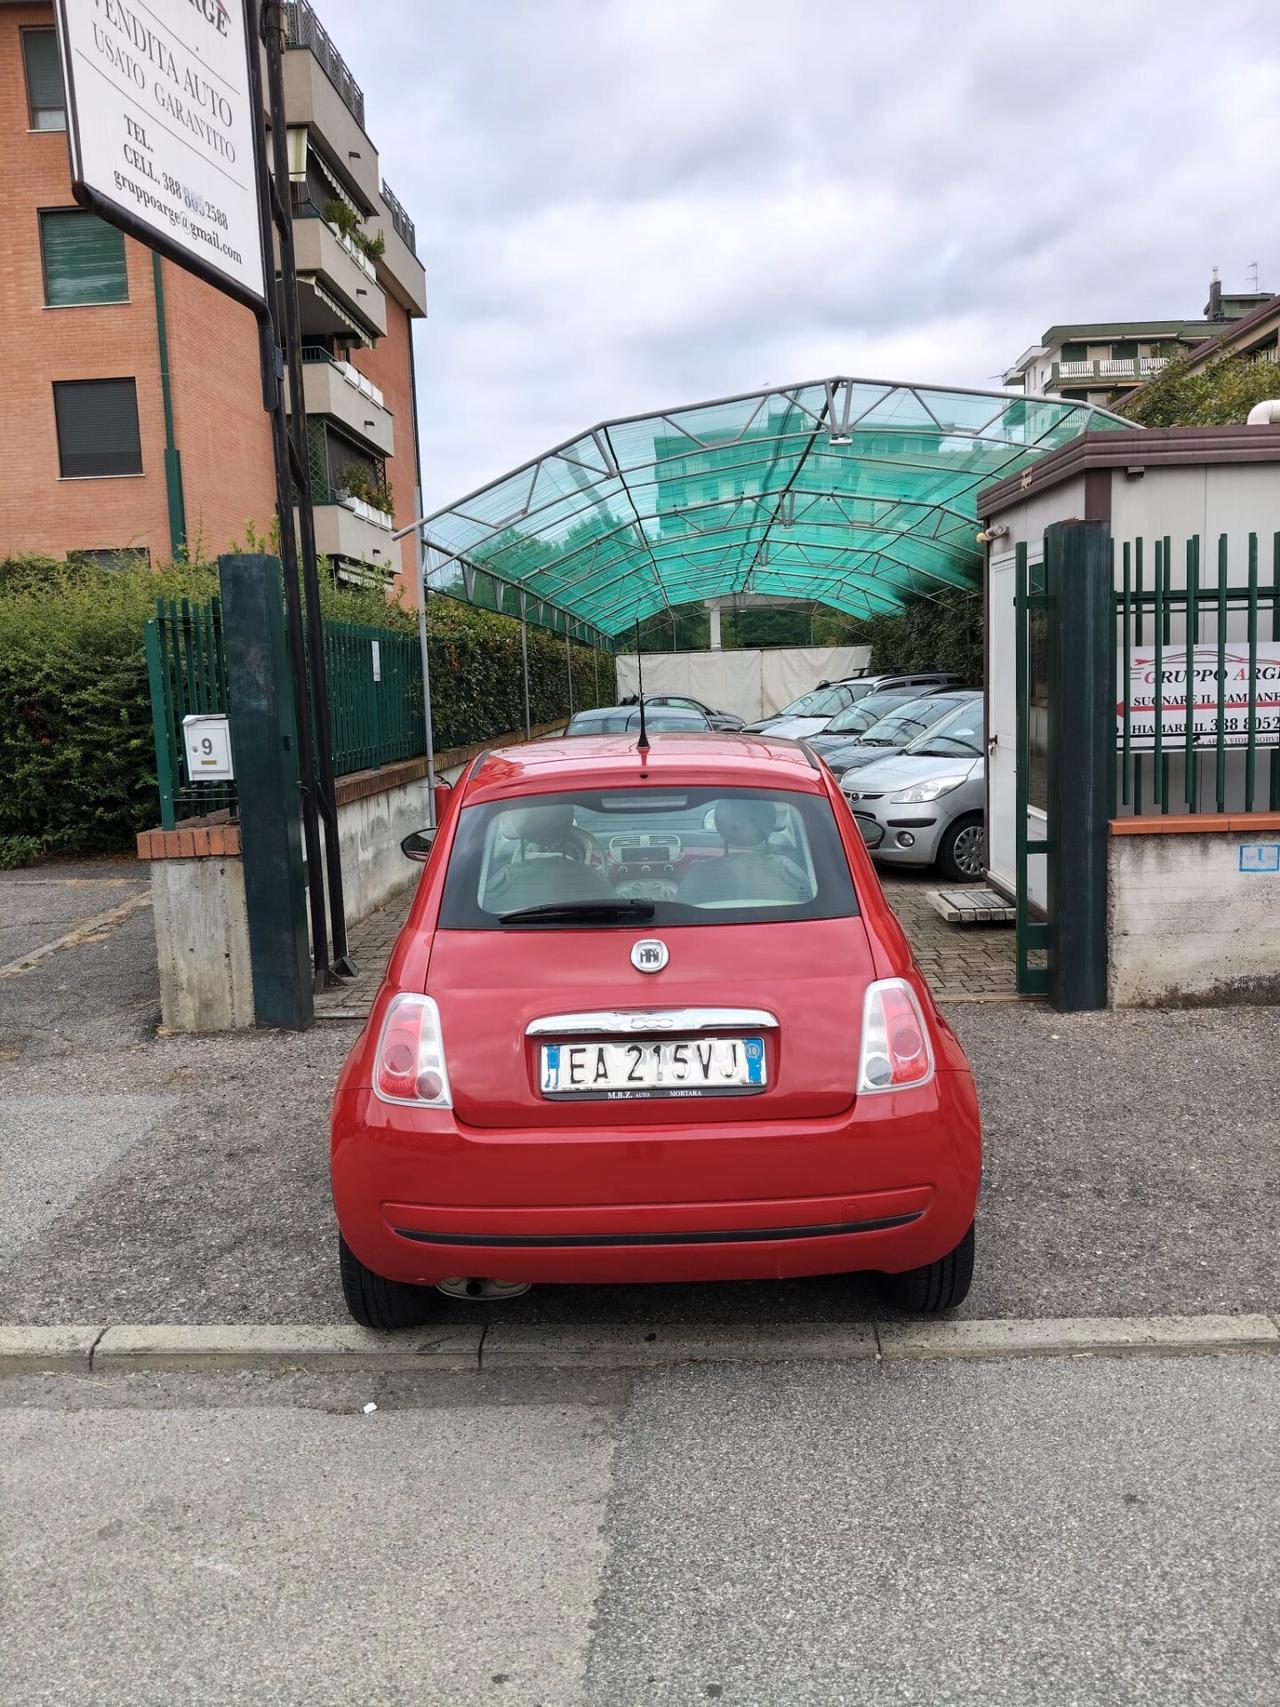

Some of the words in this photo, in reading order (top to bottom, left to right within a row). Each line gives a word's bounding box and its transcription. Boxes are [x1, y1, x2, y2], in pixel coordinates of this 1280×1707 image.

[95, 0, 179, 85] ENDITA
[184, 67, 232, 127] AUTO
[92, 20, 145, 89] USATO
[154, 82, 235, 163] GARANTITO
[124, 114, 153, 152] TEL.
[124, 144, 161, 184] CELL.
[162, 172, 182, 199] 388
[114, 170, 242, 264] gruppoarge@gmail.com
[1201, 693, 1214, 704] IL
[201, 738, 213, 756] 9
[1194, 723, 1207, 732] IL
[569, 1046, 609, 1085] EA
